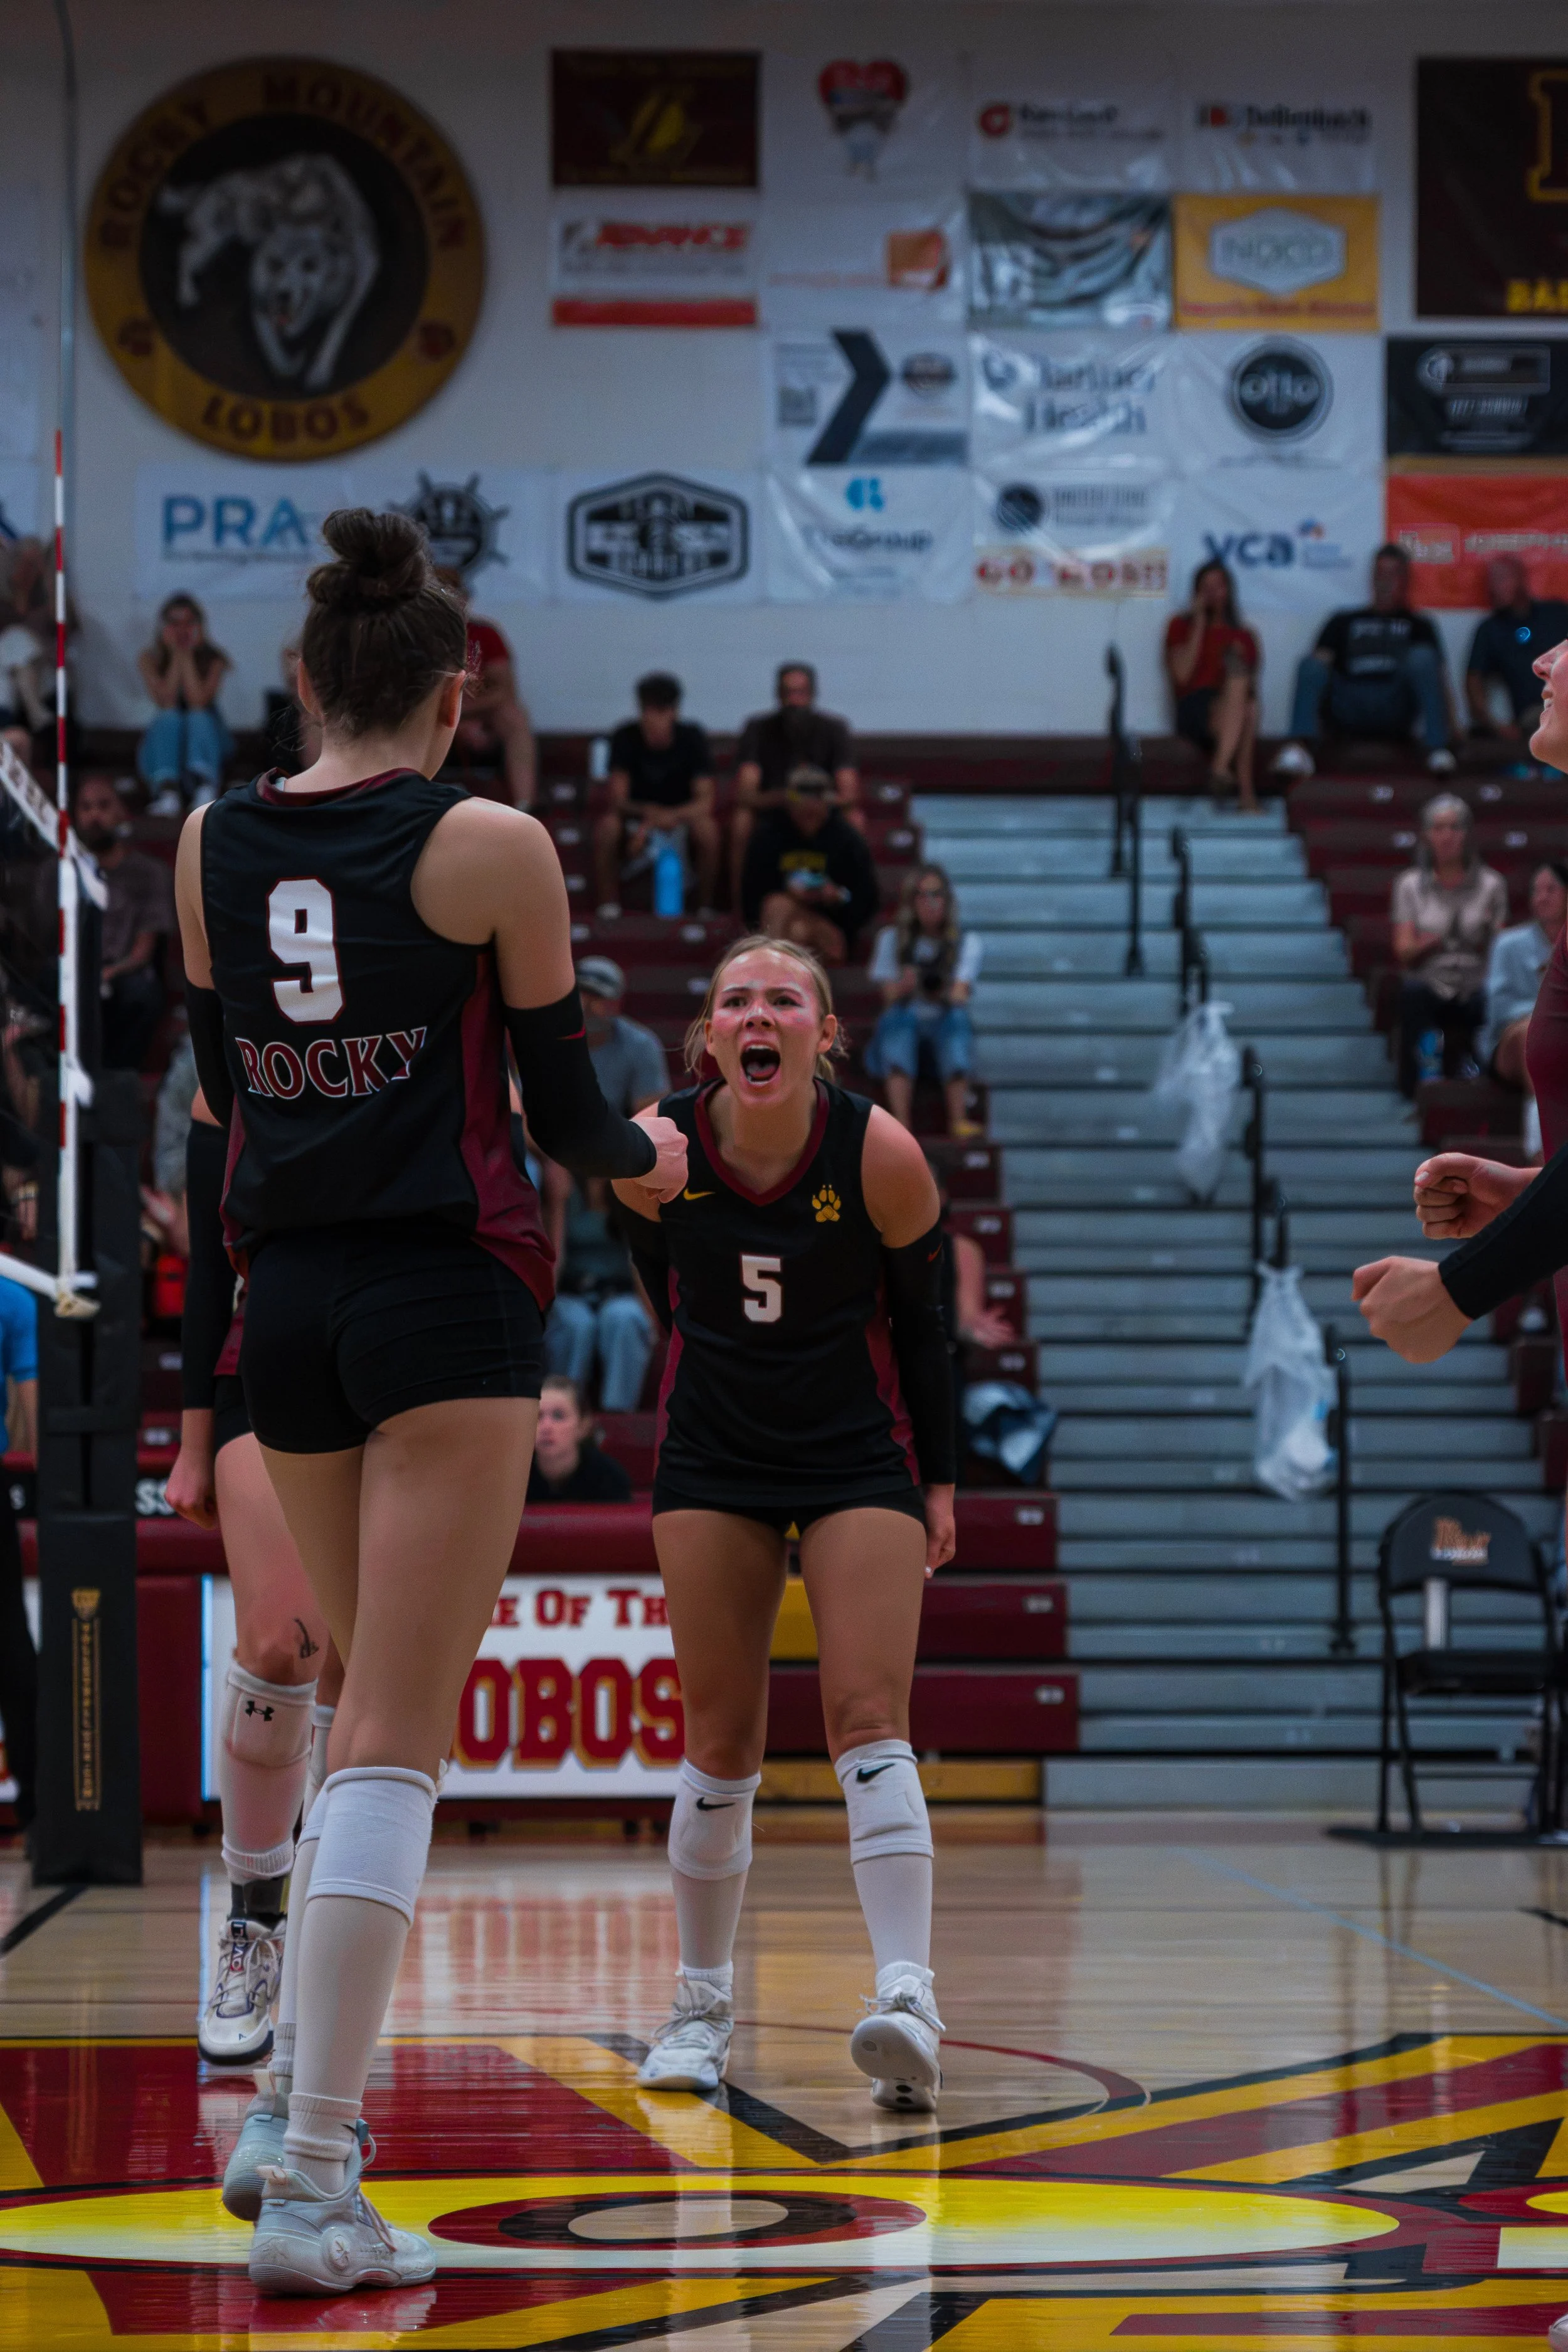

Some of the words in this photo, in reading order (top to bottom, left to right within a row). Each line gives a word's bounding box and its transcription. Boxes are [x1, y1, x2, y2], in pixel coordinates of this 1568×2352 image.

[99, 97, 209, 250] ROCKY
[261, 73, 466, 248] MOUNTAIN
[201, 395, 369, 443] LOBOS
[162, 495, 309, 547] PRA
[266, 876, 346, 1026] 9
[235, 1027, 427, 1101] ROCKY
[740, 1253, 784, 1325] 5
